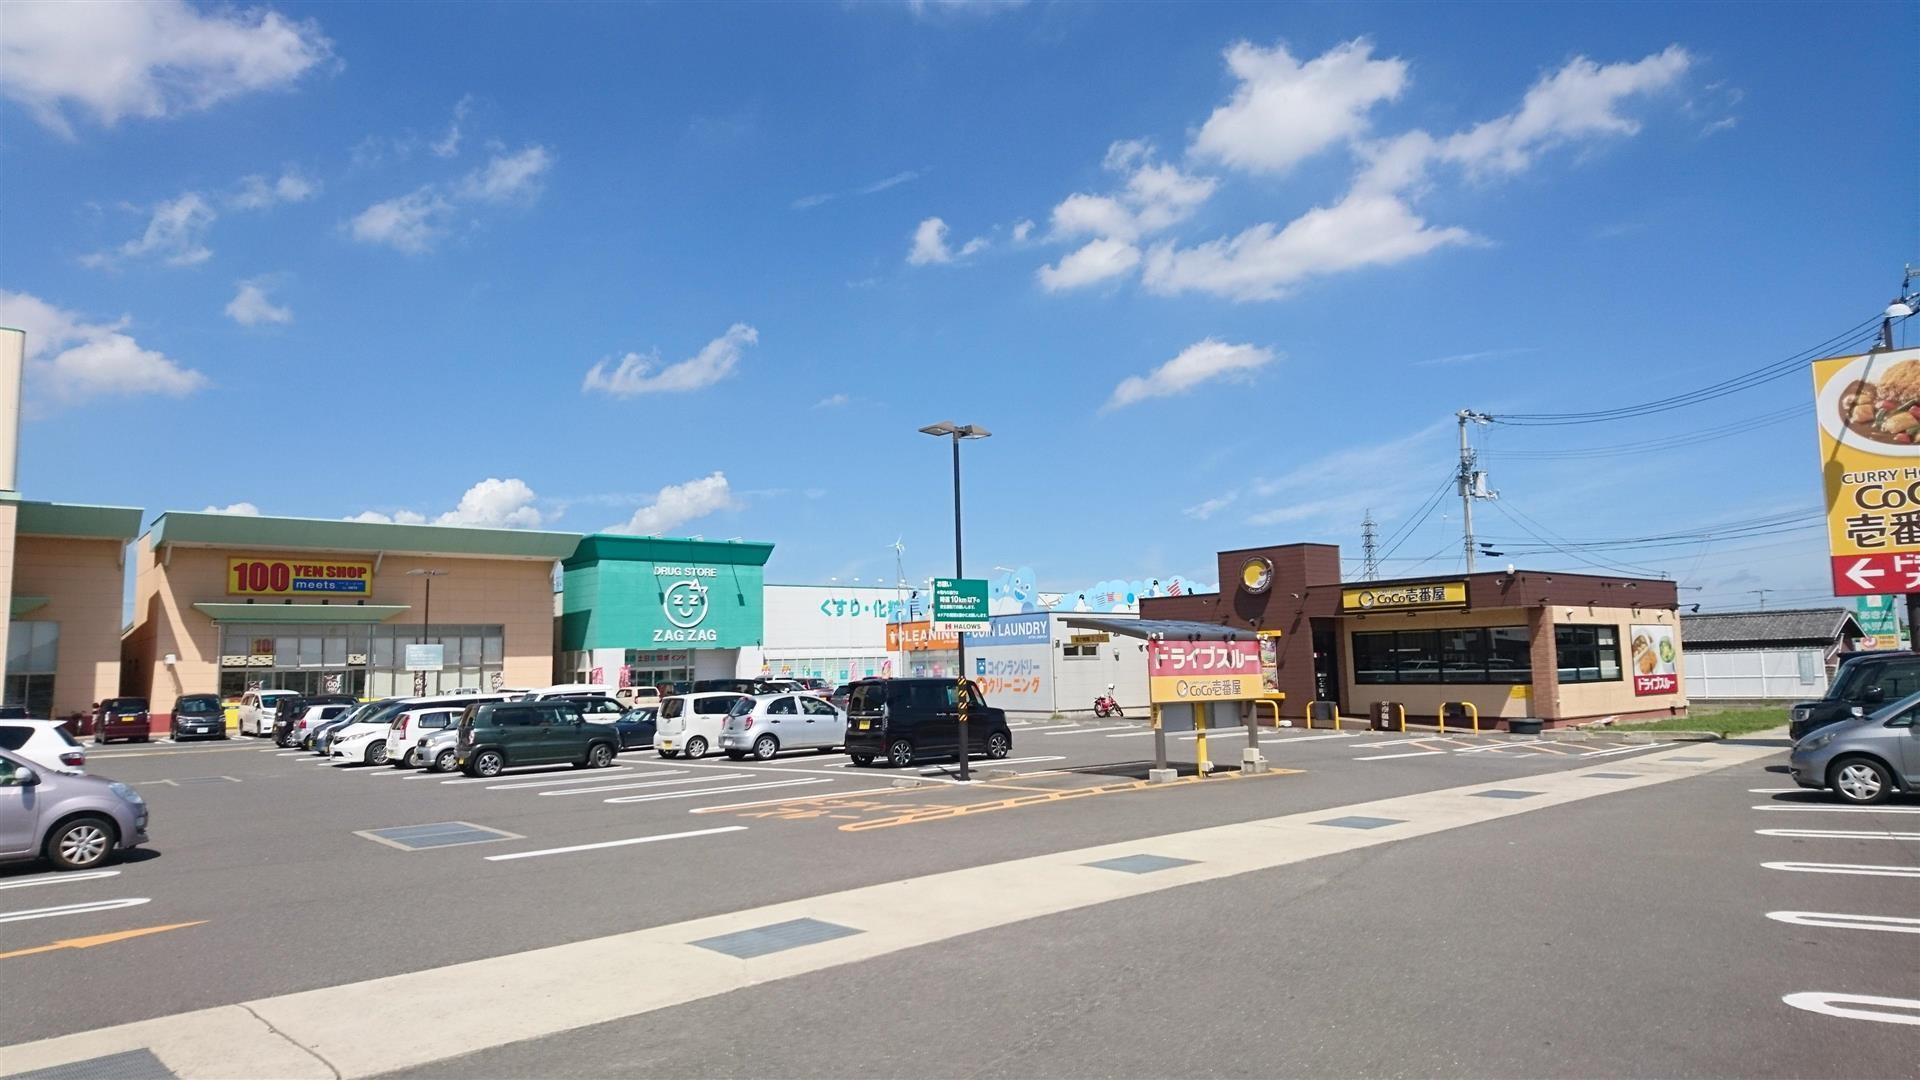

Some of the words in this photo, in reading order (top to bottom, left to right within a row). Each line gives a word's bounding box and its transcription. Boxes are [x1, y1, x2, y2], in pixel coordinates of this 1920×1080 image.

[1842, 470, 1898, 484] CURRY
[1904, 467, 1920, 479] H
[233, 562, 290, 592] 100
[293, 564, 324, 578] YEN
[326, 566, 367, 579] SHOP
[653, 566, 682, 577] DRUG
[684, 567, 717, 578] STORE
[296, 580, 336, 590] meets
[1377, 586, 1445, 604] CoCo壱番屋
[653, 629, 684, 642] ZAG
[687, 628, 718, 641] ZAG
[998, 621, 1047, 637] LAUNDRY
[1154, 645, 1258, 670] ドライブスルー
[987, 658, 1040, 676] コインランドリー
[989, 676, 1041, 693] クリーニング
[1189, 679, 1241, 697] CoCo壱番屋
[1637, 676, 1676, 691] ドライブスルー
